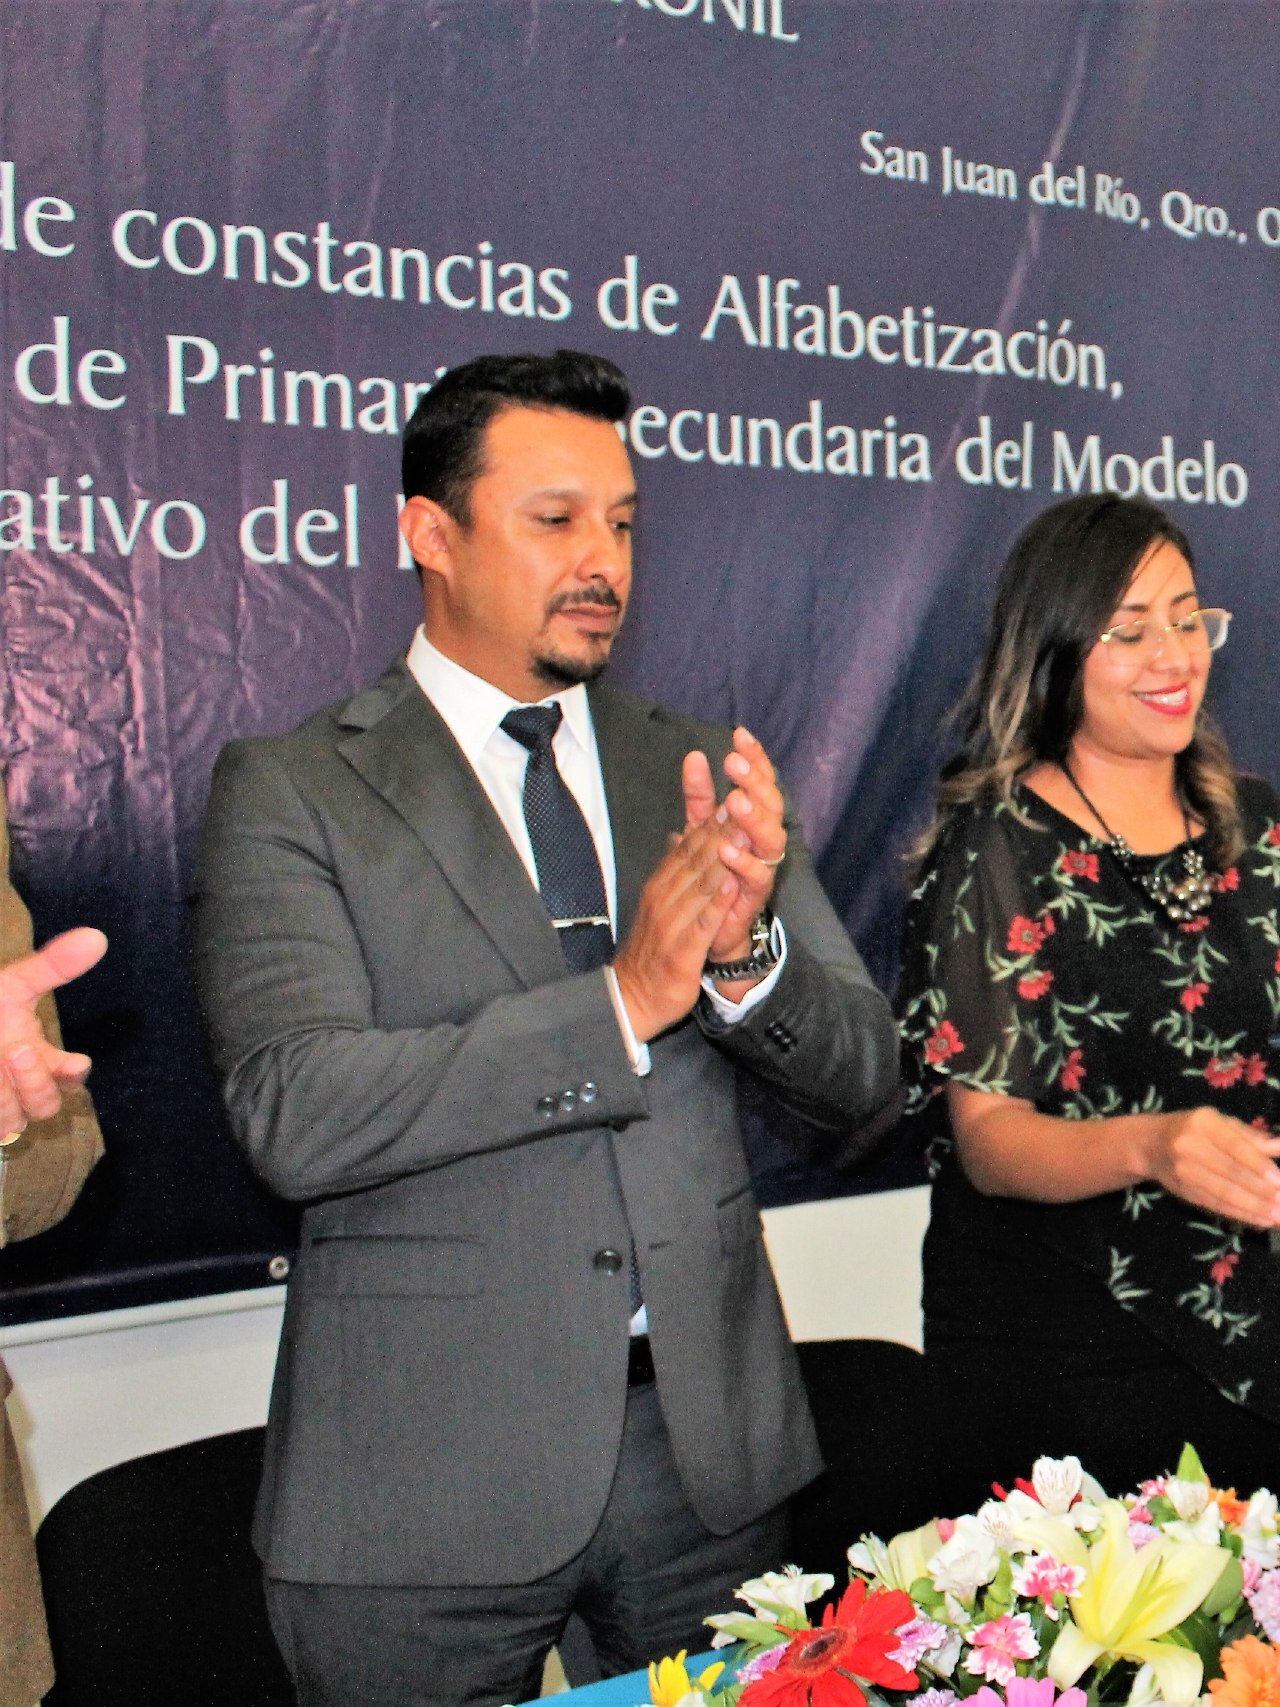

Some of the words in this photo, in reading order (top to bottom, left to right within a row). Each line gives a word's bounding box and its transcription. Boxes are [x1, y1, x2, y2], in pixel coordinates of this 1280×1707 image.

[859, 129, 929, 184] San
[941, 145, 1018, 200] Juan
[1028, 160, 1087, 208] del
[111, 208, 573, 322] constancias
[597, 253, 679, 337] de
[700, 273, 1123, 400] Alfabetización,
[13, 314, 127, 411] de
[165, 333, 449, 437] Primar
[614, 398, 933, 483] ecundaria
[954, 414, 1034, 490] del
[1051, 429, 1249, 508] Modelo
[239, 477, 360, 569] del
